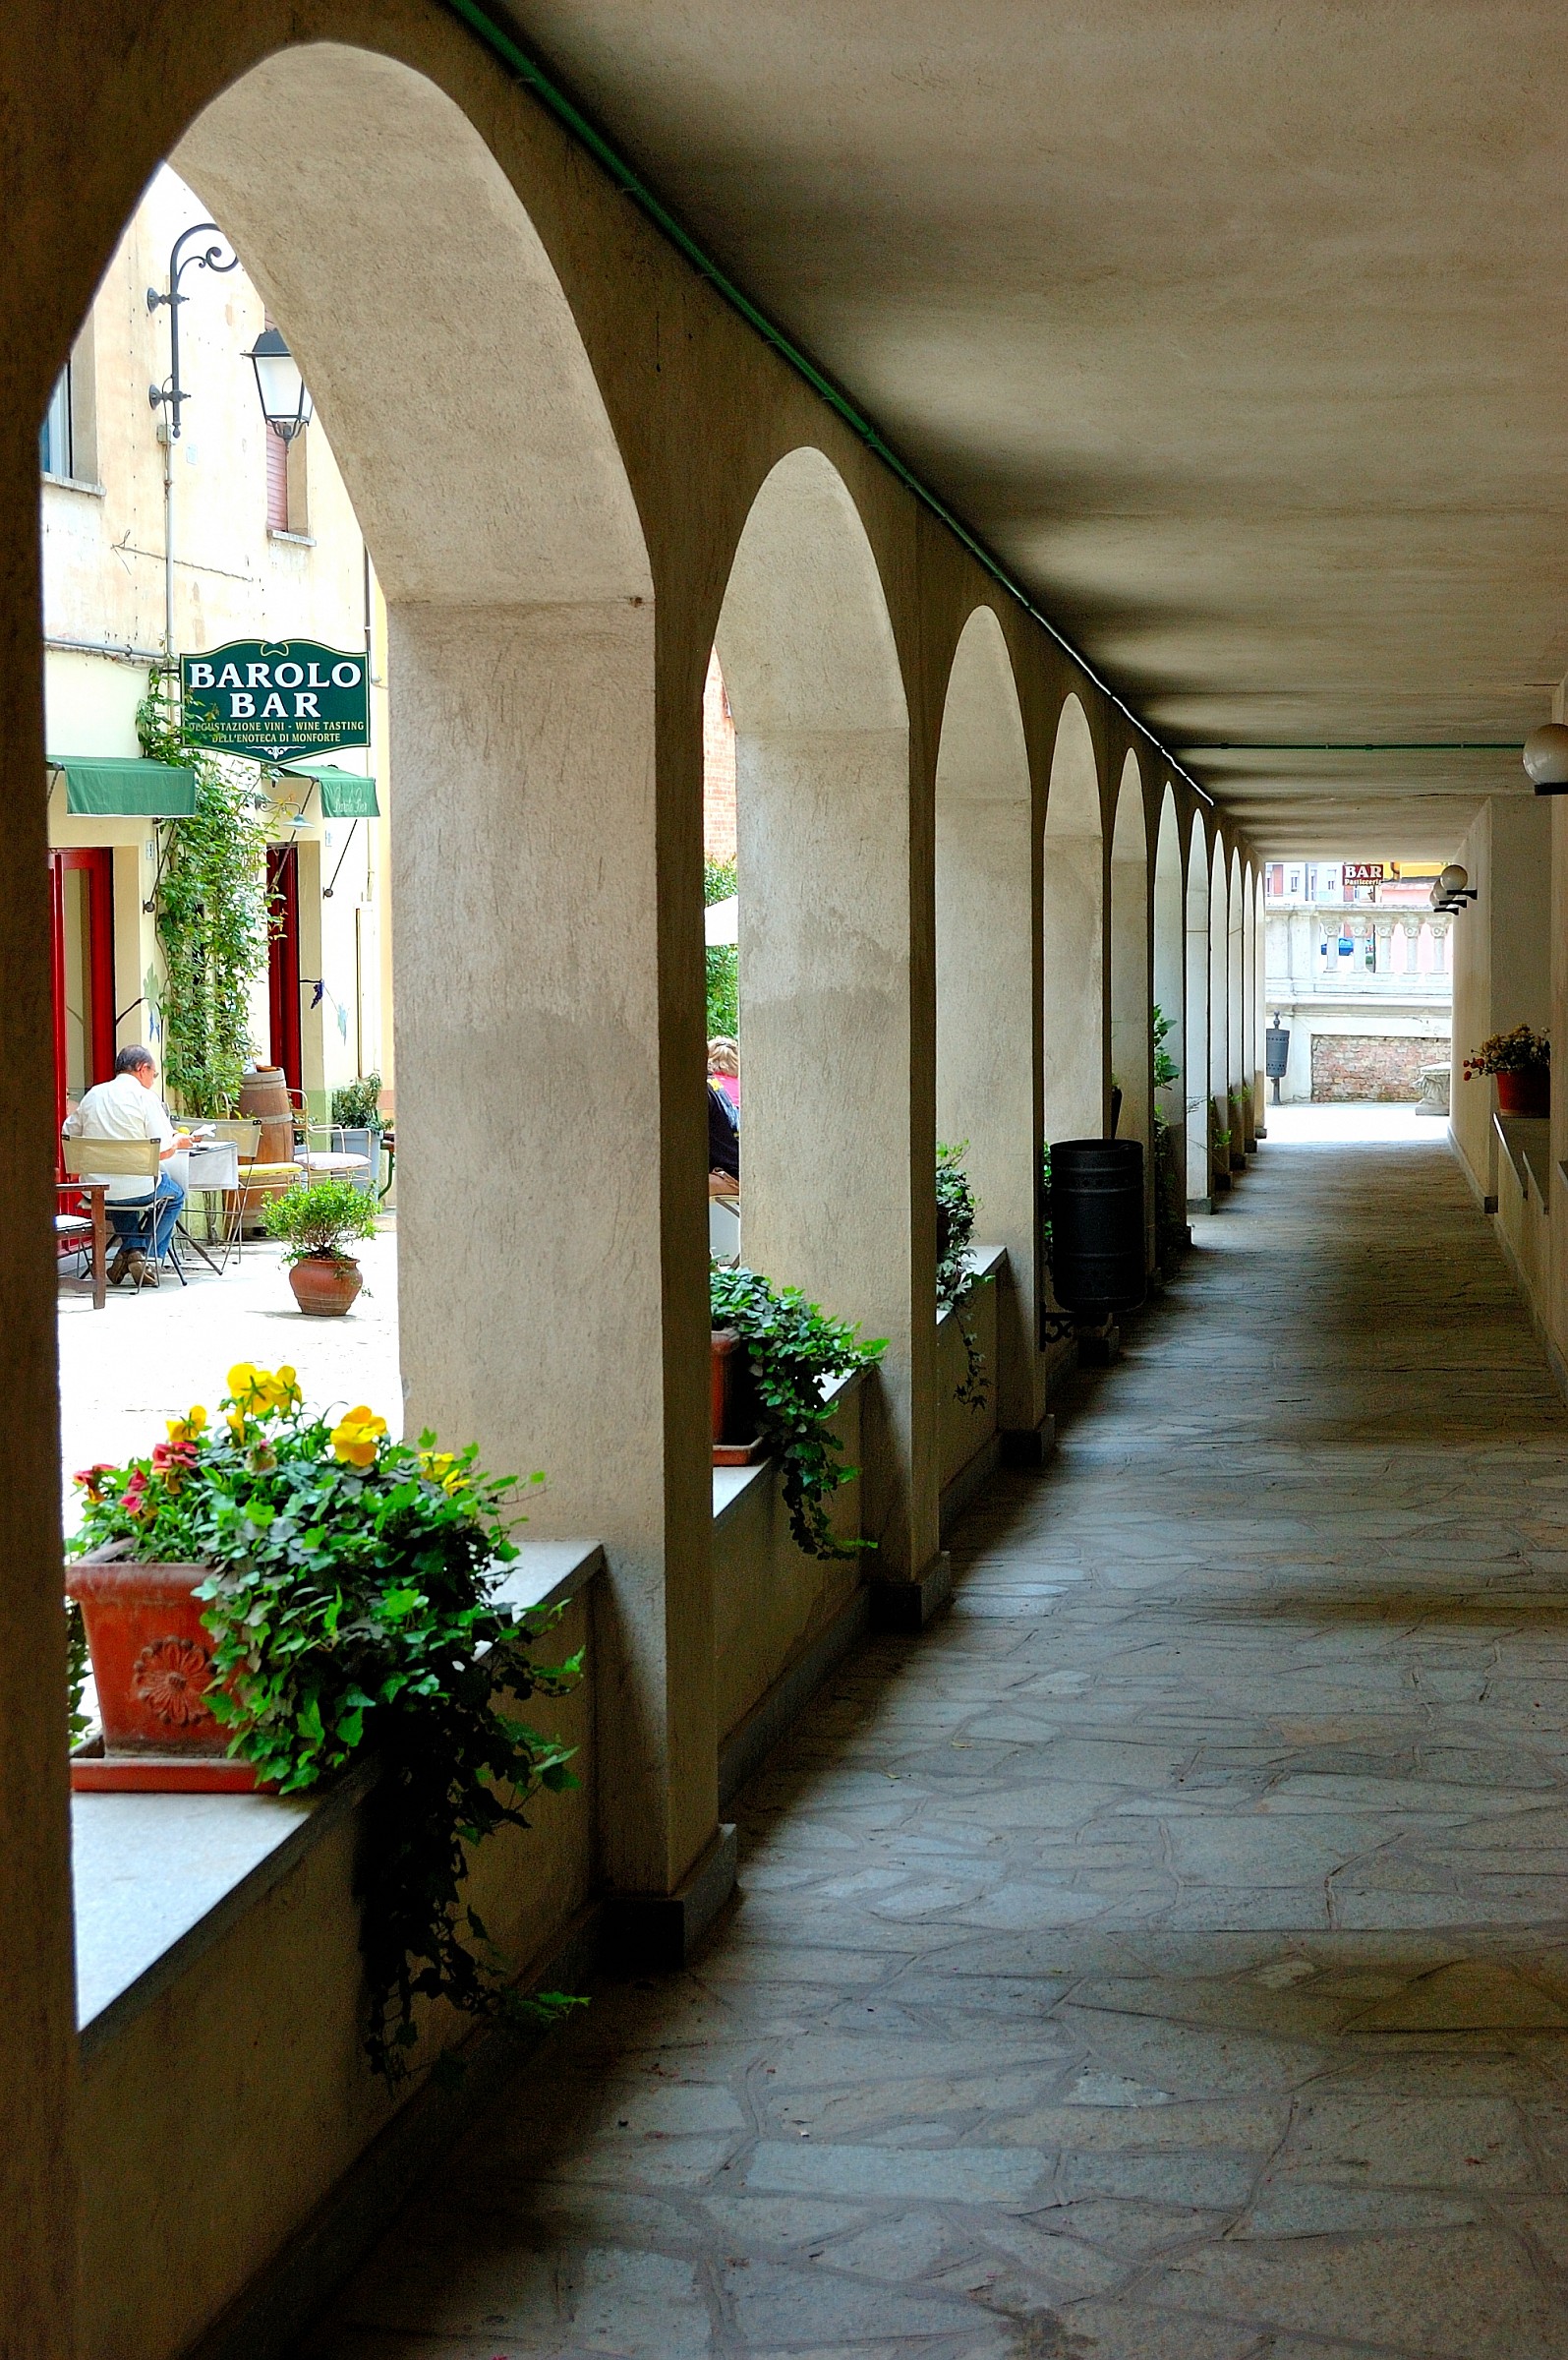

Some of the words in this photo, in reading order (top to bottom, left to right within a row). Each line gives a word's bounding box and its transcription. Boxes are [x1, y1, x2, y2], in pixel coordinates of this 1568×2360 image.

[189, 662, 362, 688] BAROLO
[229, 692, 321, 718] BAR
[263, 721, 285, 731] VINI
[295, 721, 320, 731] WINE
[322, 721, 364, 731] TASTING
[279, 734, 289, 742] DI
[292, 733, 341, 742] MONFORTE
[1344, 865, 1382, 878] BAR
